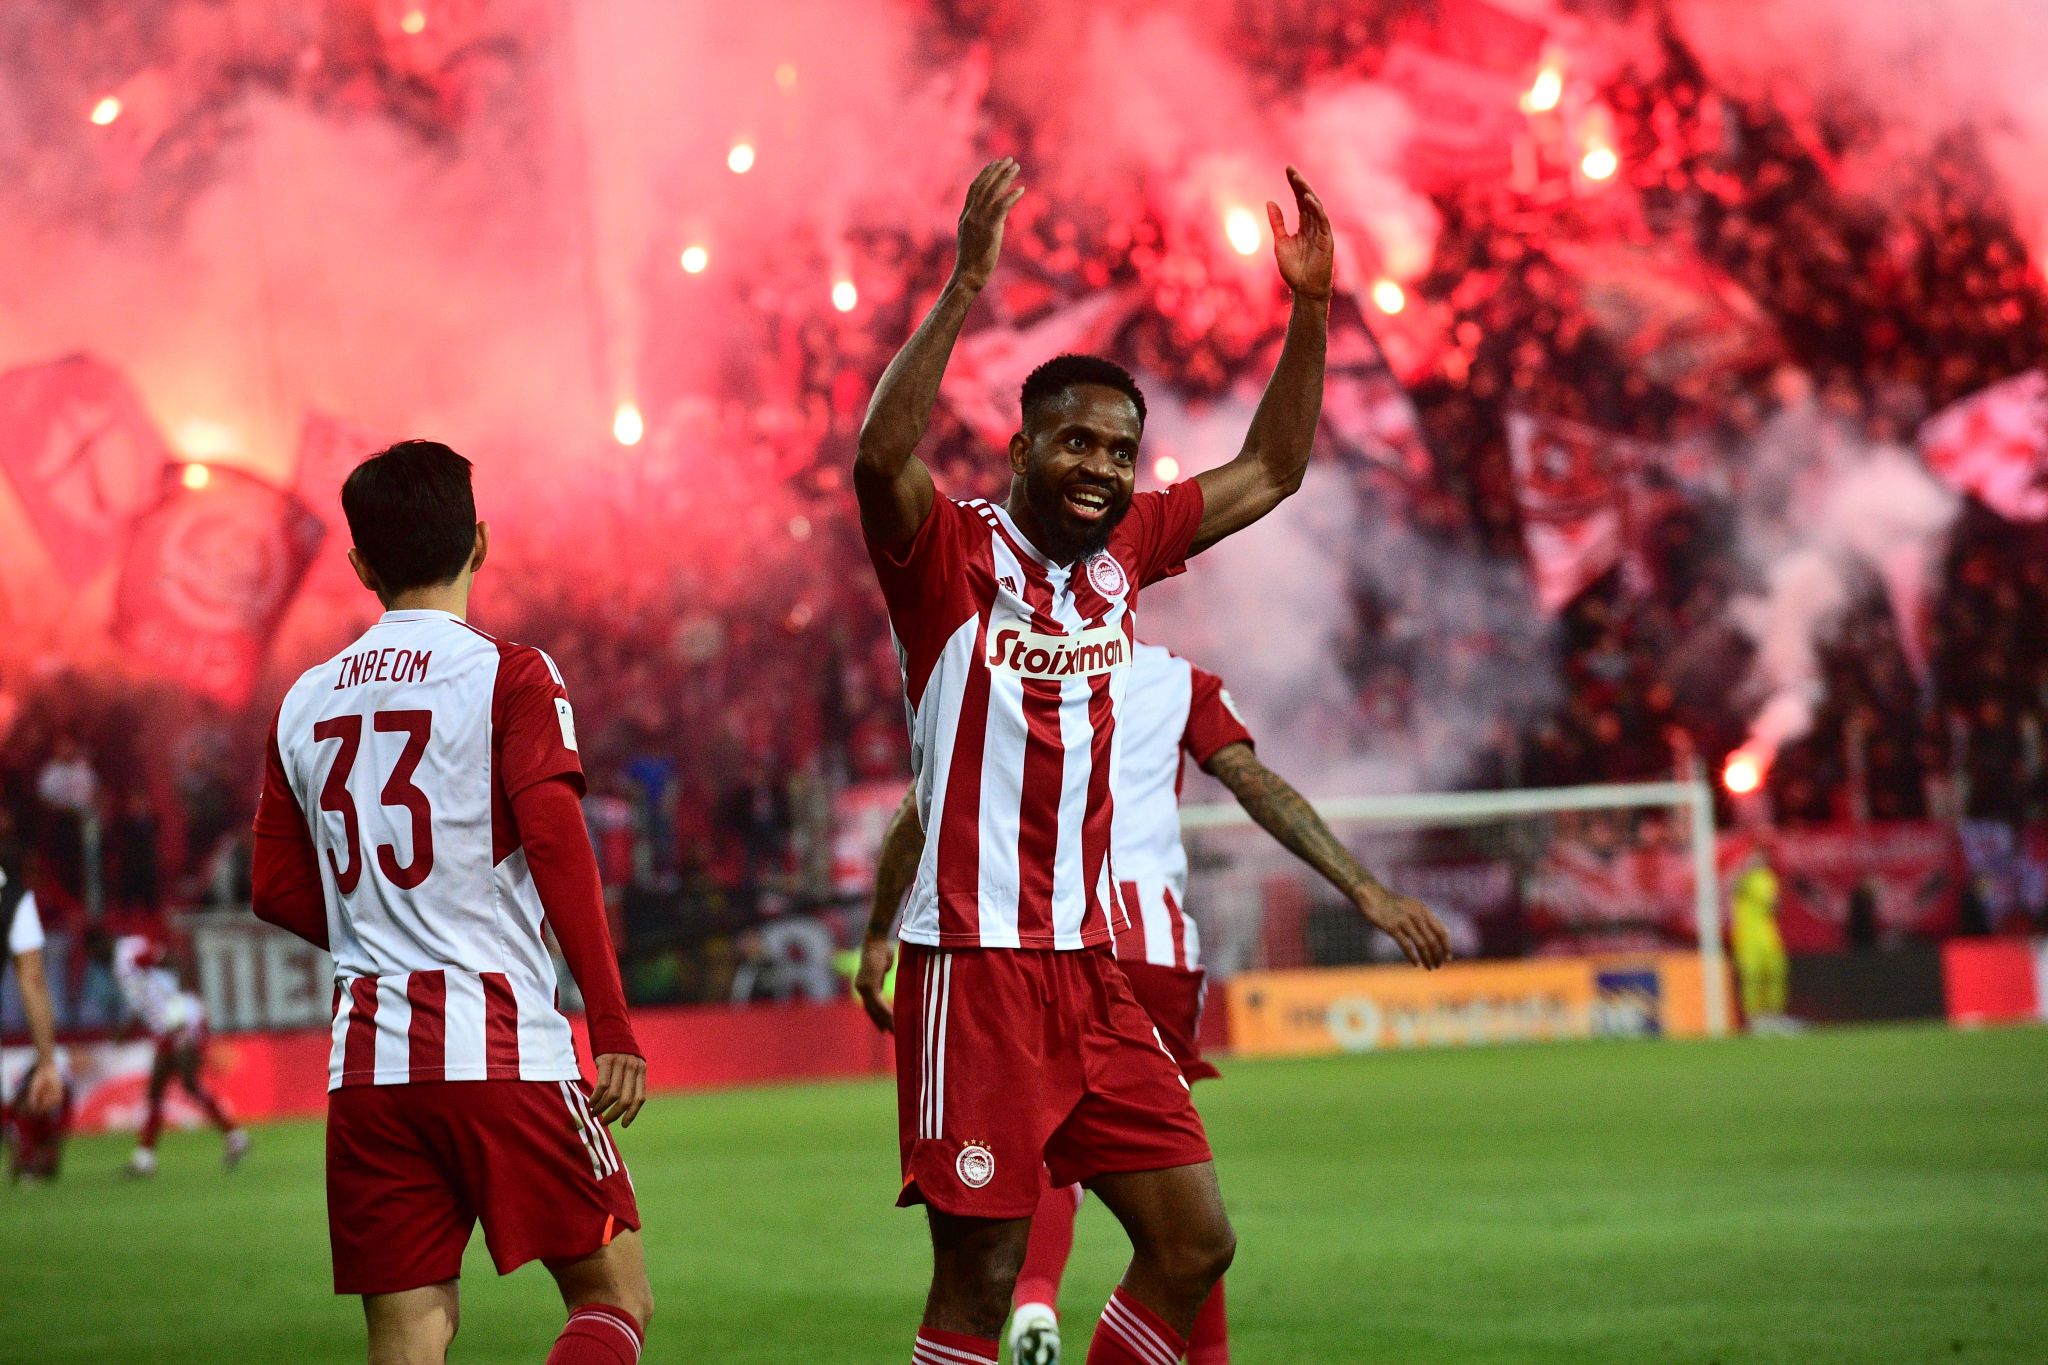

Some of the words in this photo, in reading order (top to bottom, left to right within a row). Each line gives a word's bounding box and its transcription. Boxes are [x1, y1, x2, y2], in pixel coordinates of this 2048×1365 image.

[334, 648, 432, 690] INBEOM
[989, 629, 1123, 675] Stoiximan
[314, 710, 433, 894] 33
